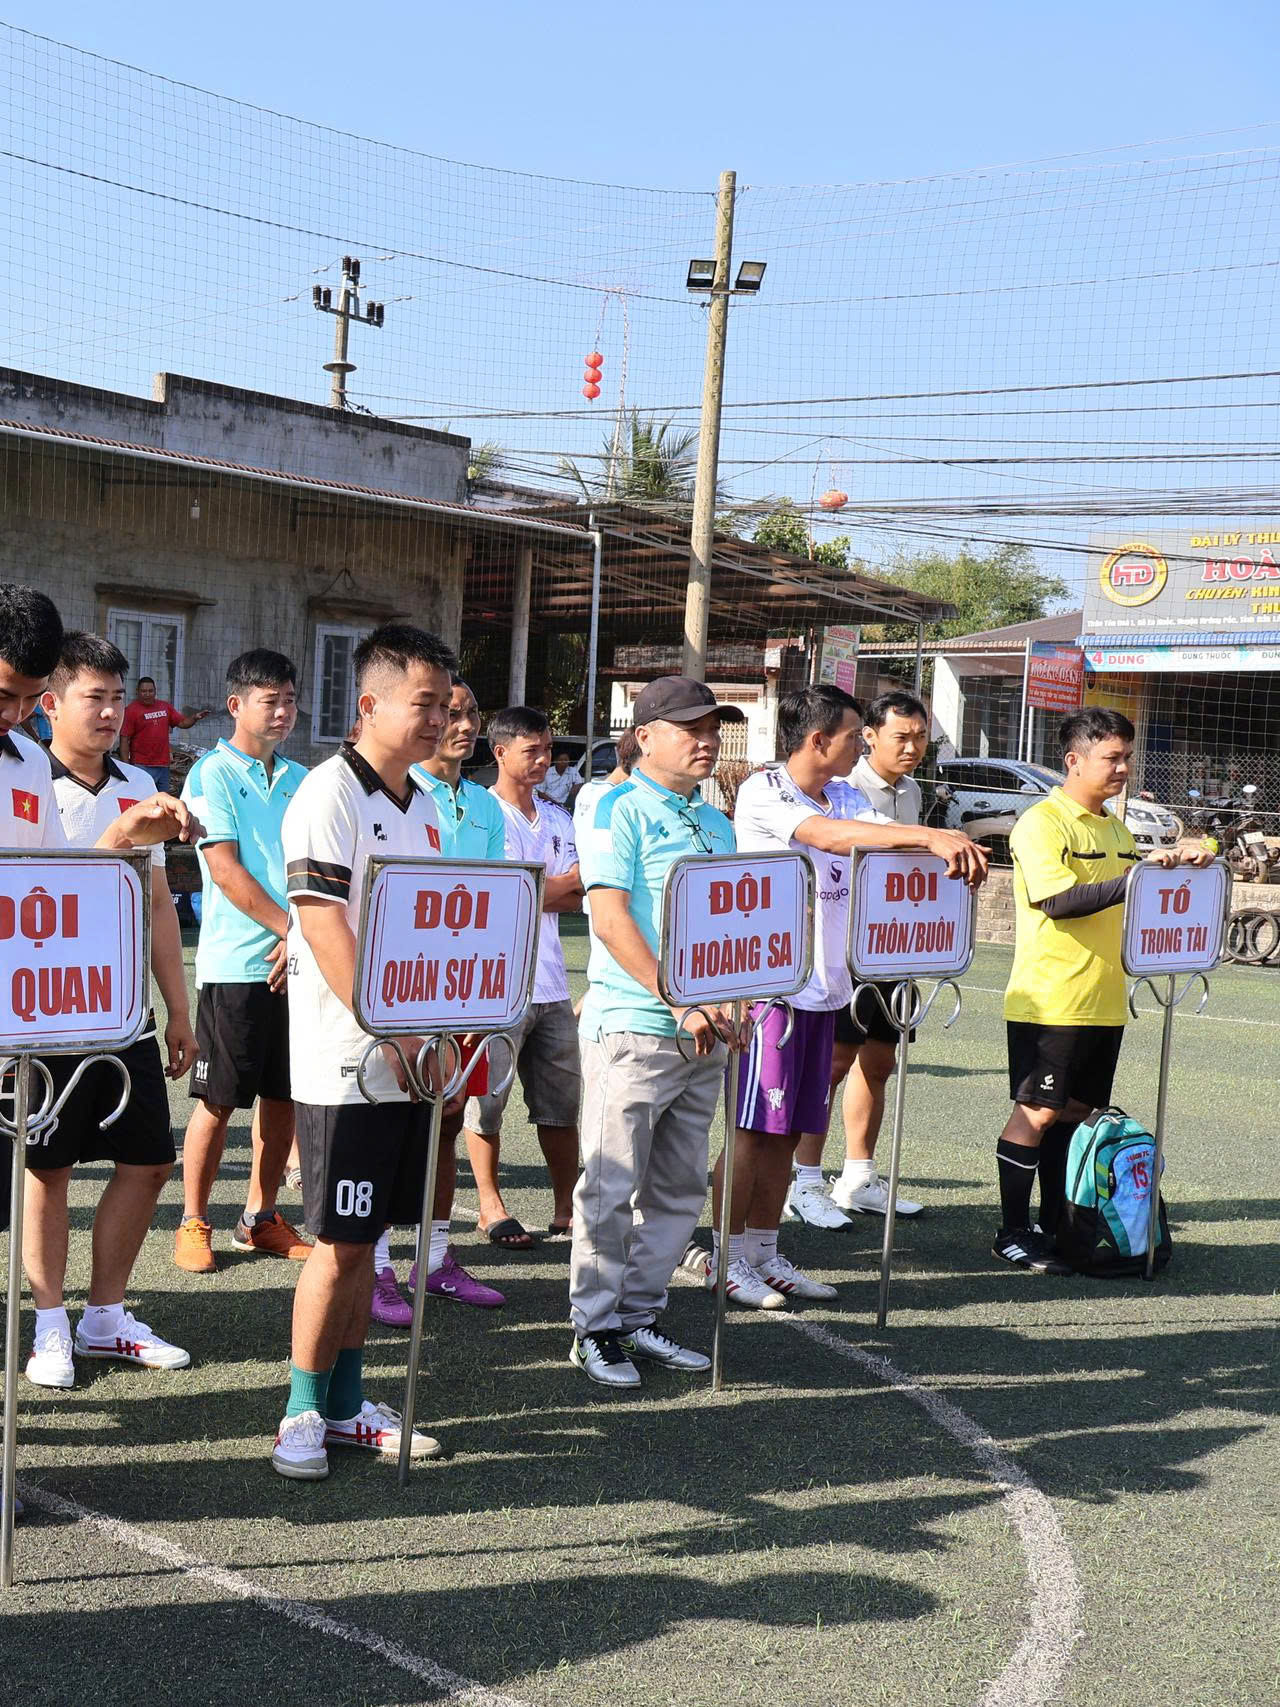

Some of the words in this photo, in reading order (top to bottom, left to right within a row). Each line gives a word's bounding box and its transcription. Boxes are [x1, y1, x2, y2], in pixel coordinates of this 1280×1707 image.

[1223, 531, 1241, 546] LÝ
[708, 872, 771, 918] ĐỘI
[884, 867, 937, 908] ĐỘI
[1158, 878, 1192, 914] TỔ
[414, 884, 490, 937] ĐỘI
[690, 933, 761, 979] HOÀNG
[767, 931, 792, 969] SA
[868, 915, 956, 955] THÔN/BUÔN
[1140, 926, 1183, 959] TRỌNG
[1187, 922, 1208, 952] TÀI
[12, 965, 112, 1022] QUAN
[381, 952, 440, 1008] QUÂN
[444, 953, 478, 1008] SỰ
[478, 952, 506, 999] XÃ
[336, 1180, 373, 1217] 08
